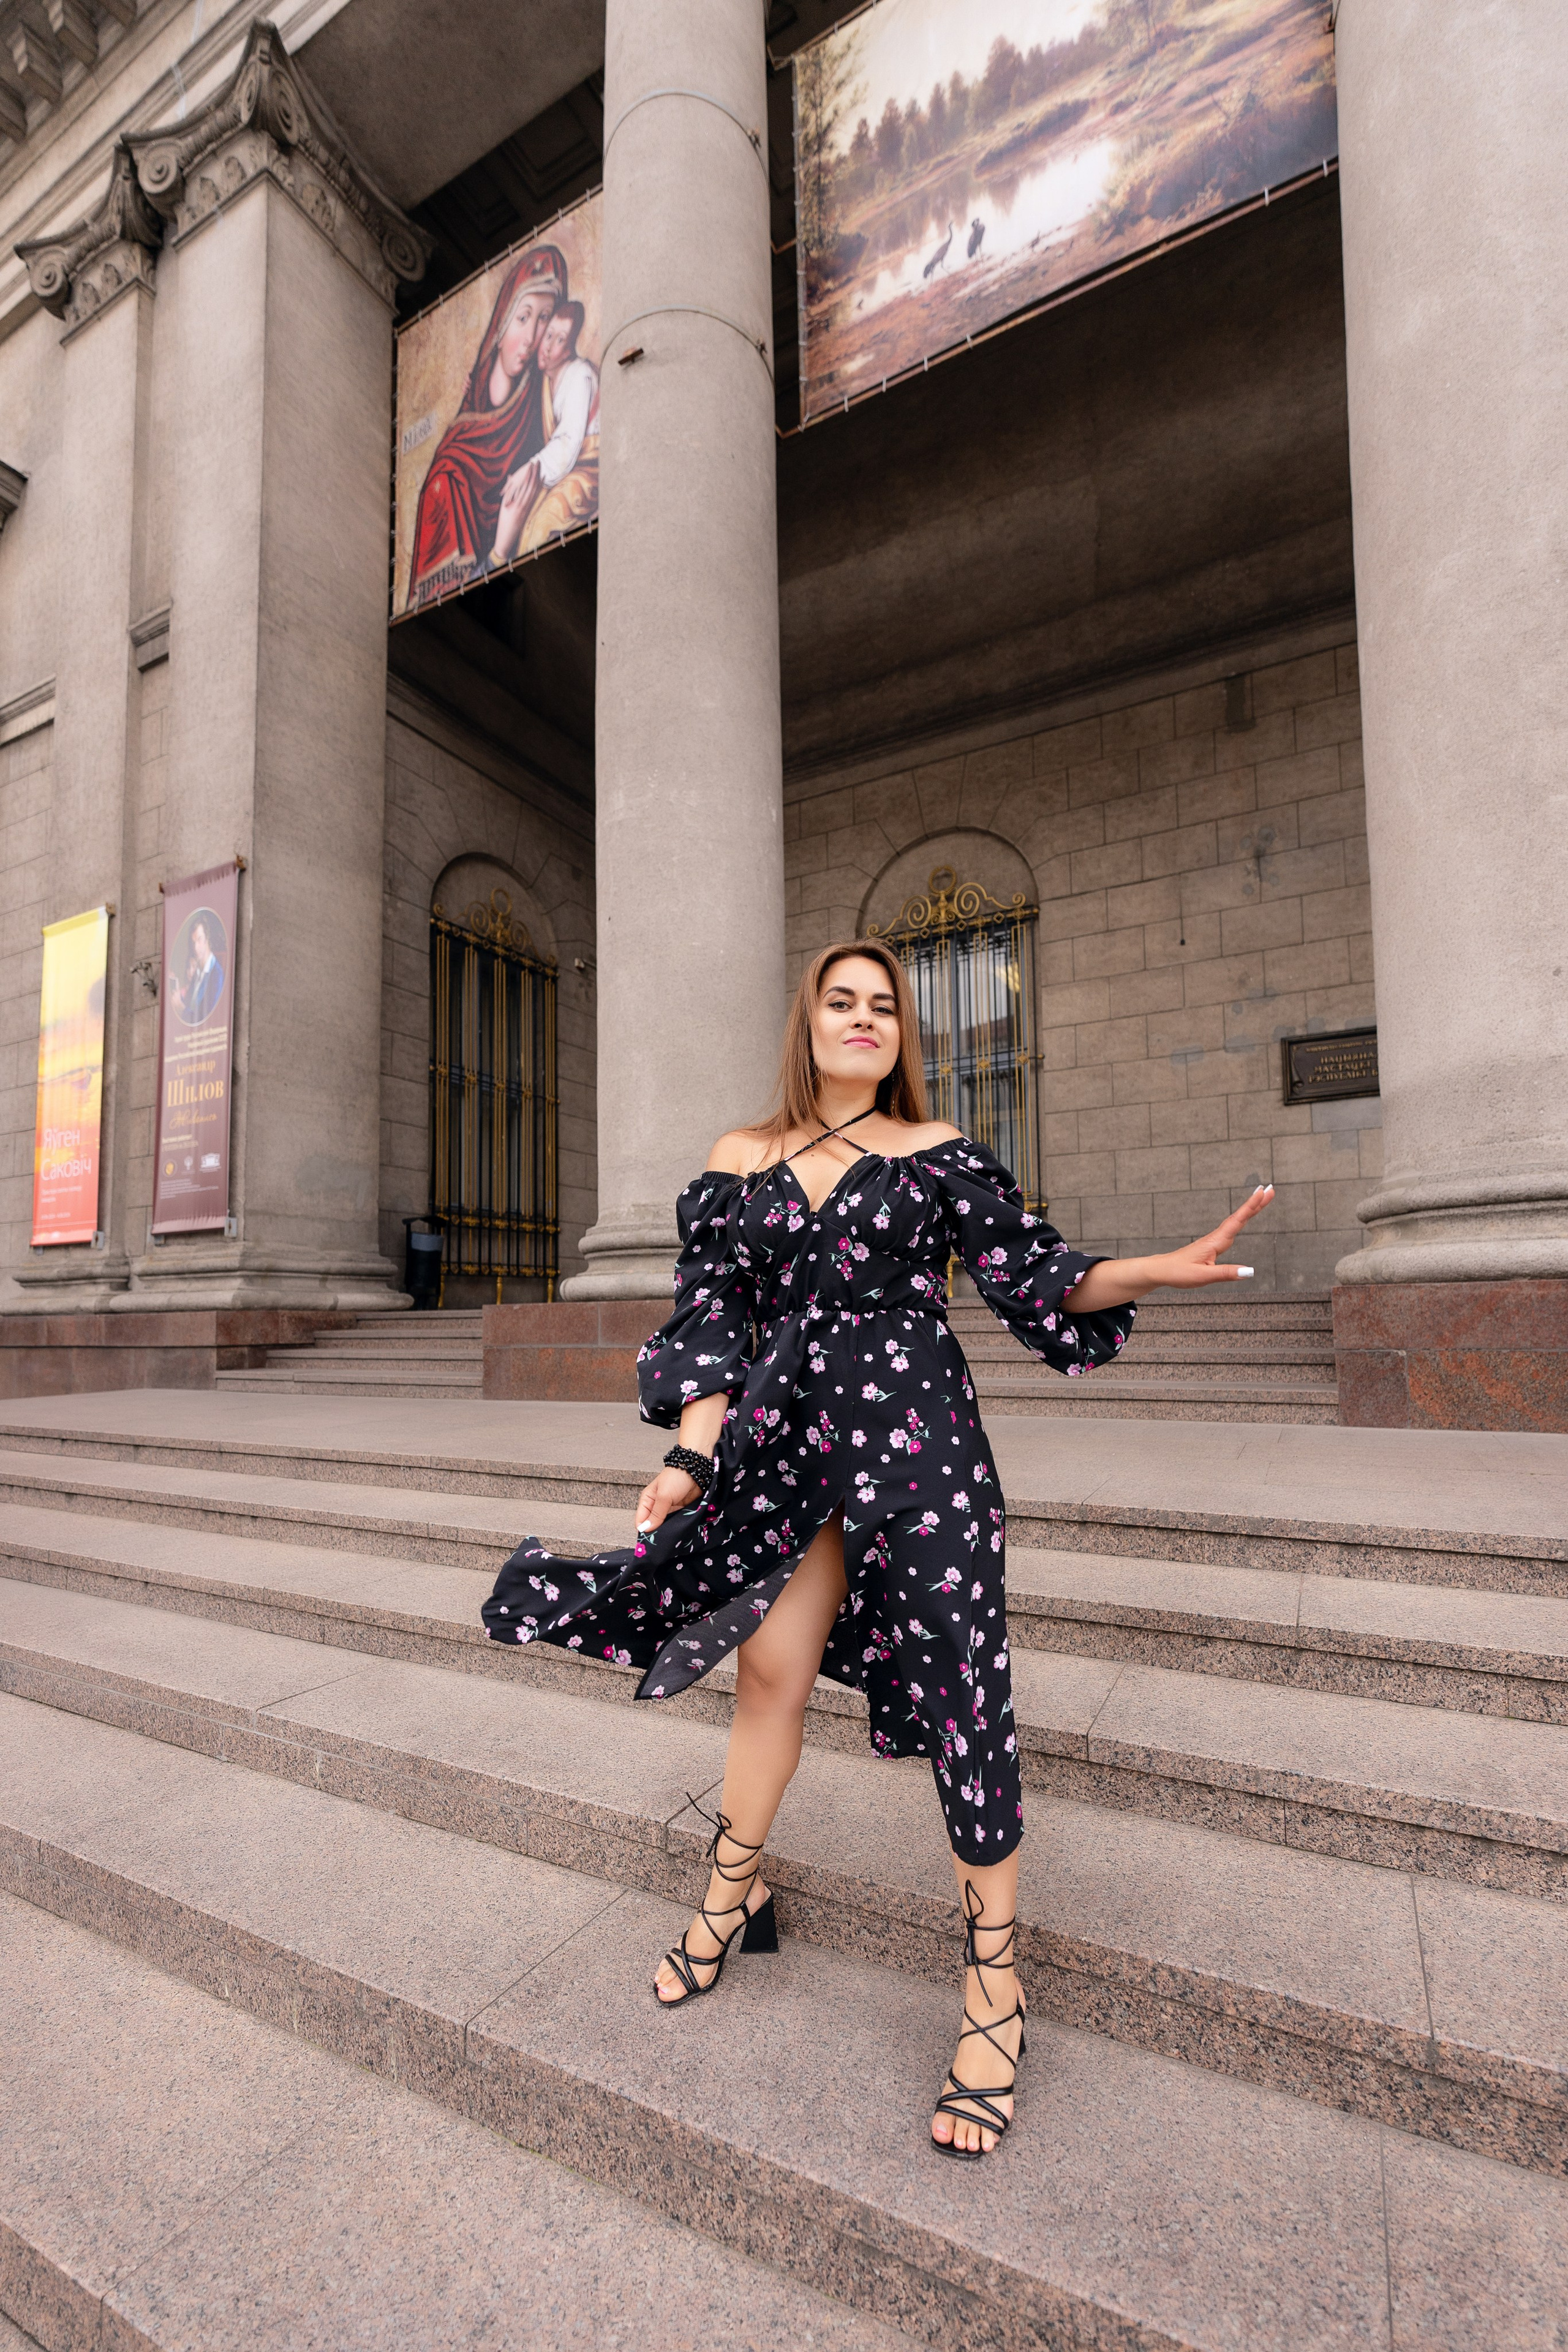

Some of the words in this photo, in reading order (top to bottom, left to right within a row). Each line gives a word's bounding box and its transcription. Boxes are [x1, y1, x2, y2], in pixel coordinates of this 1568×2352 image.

[1321, 1051, 1376, 1065] НАЦЫЯНА
[167, 1079, 224, 1108] Шилов
[43, 1128, 80, 1155] Яўген
[41, 1155, 91, 1181] Саковіч
